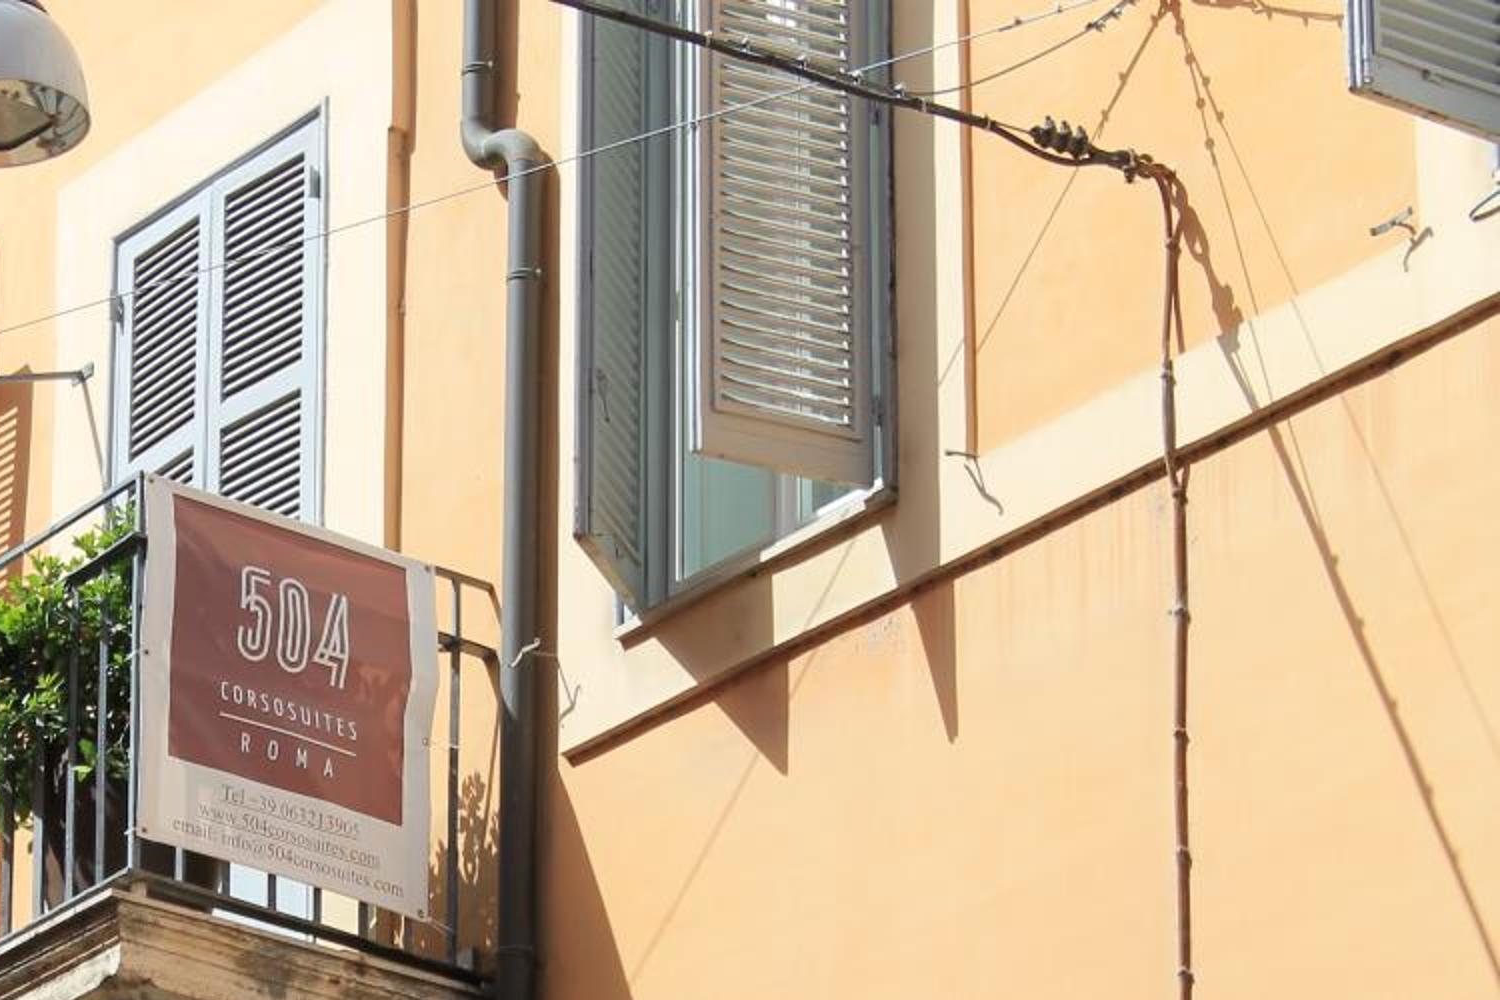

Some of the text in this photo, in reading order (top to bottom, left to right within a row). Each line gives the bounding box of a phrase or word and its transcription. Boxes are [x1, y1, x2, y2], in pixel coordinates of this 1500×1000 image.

[236, 565, 350, 689] 504
[220, 681, 357, 741] CORSOSUITES
[240, 734, 335, 777] ROMA
